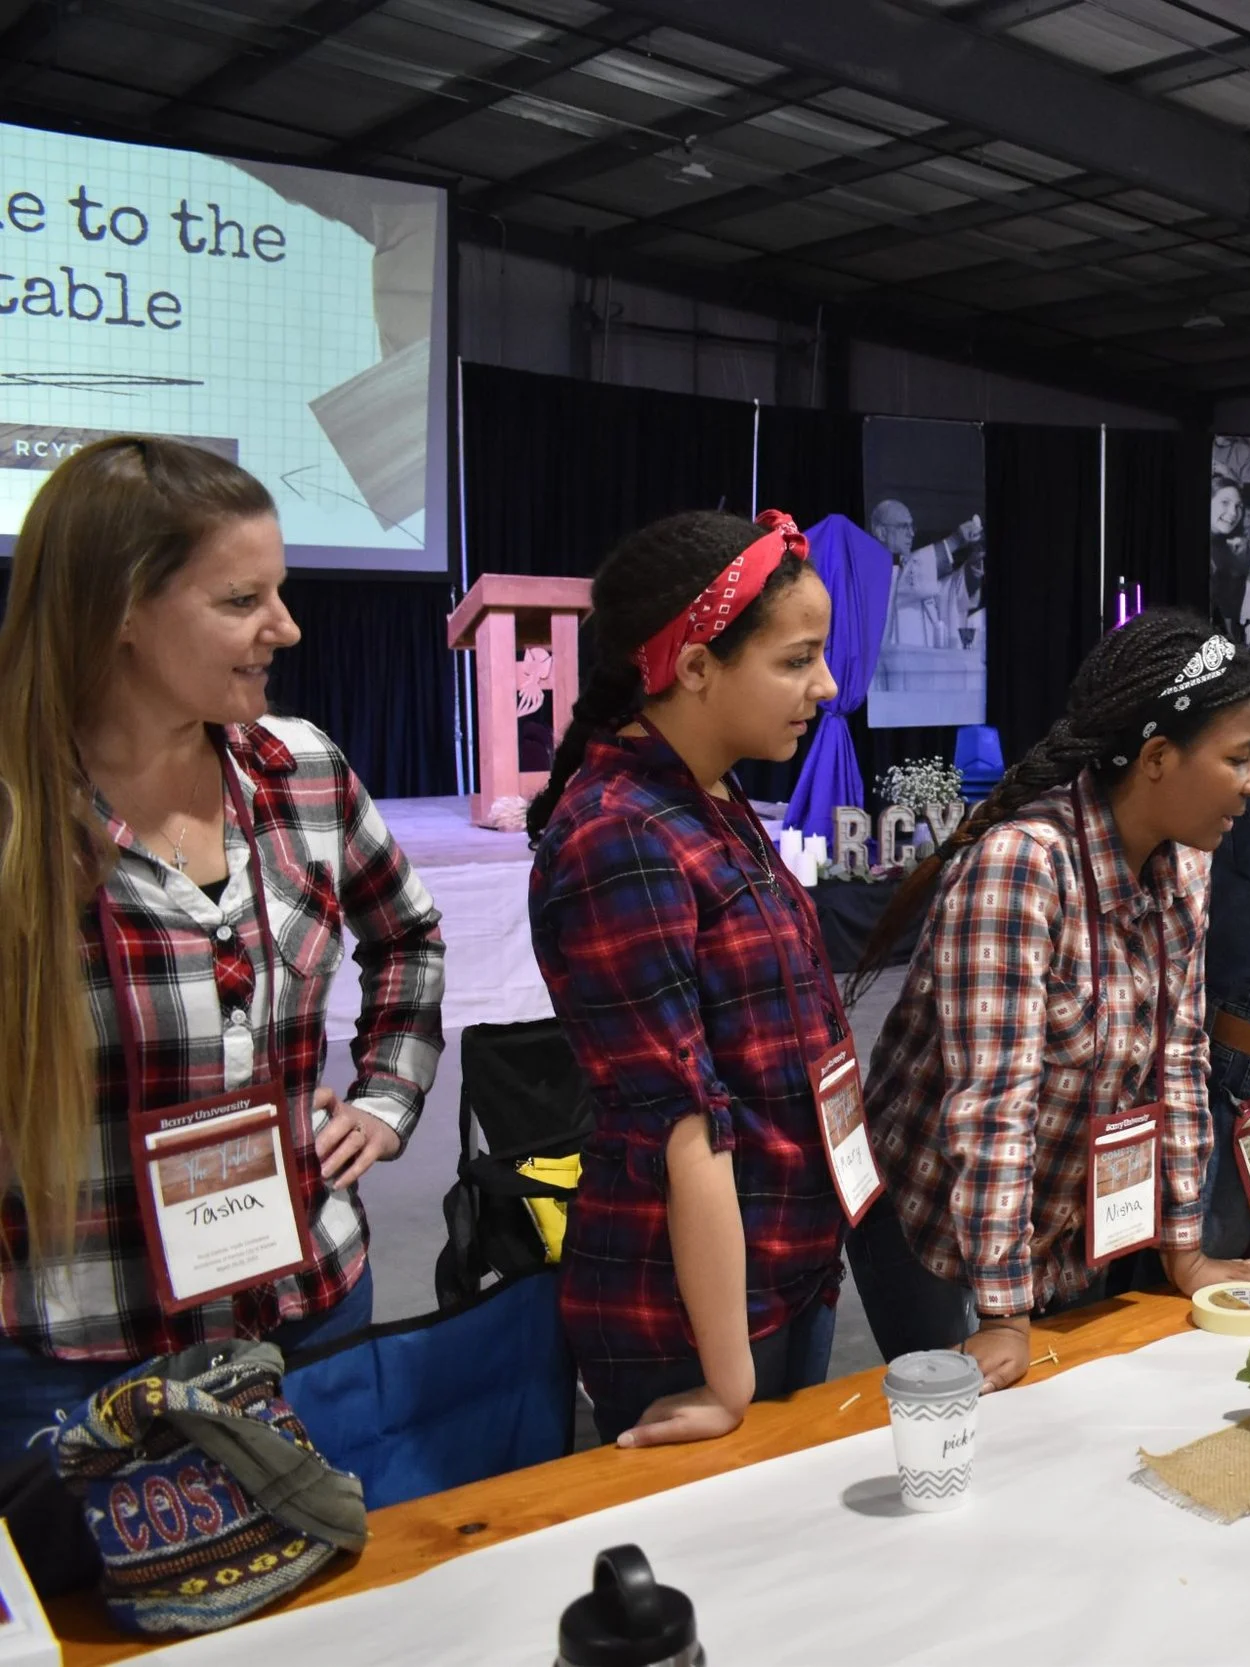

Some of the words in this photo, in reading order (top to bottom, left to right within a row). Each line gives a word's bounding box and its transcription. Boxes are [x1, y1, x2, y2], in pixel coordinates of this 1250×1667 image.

[68, 185, 149, 246] to
[170, 199, 286, 262] the
[161, 1115, 194, 1129] Barry
[195, 1099, 250, 1119] University
[185, 1194, 264, 1226] Tasha
[1105, 1199, 1143, 1223] Nisha
